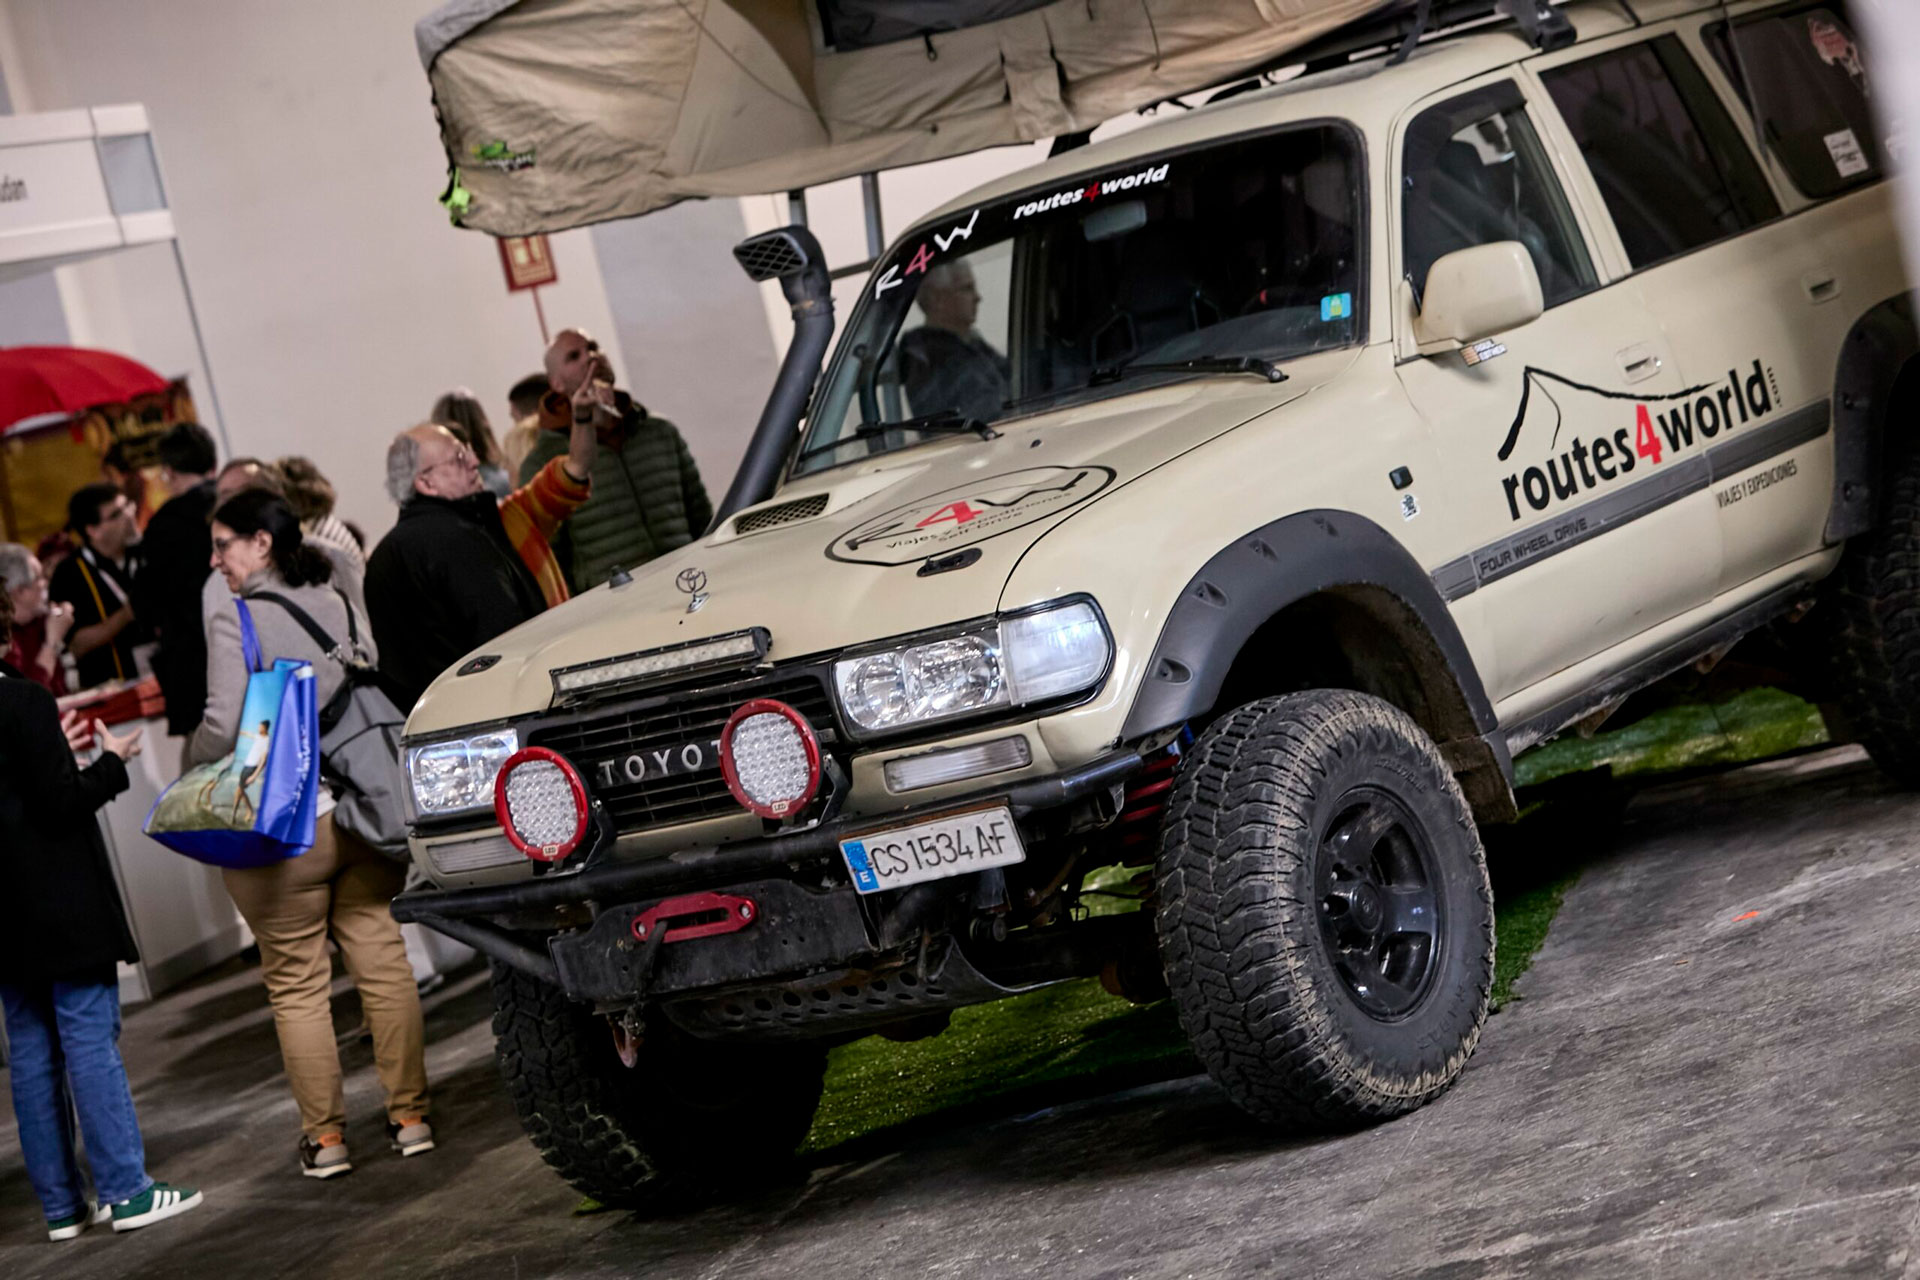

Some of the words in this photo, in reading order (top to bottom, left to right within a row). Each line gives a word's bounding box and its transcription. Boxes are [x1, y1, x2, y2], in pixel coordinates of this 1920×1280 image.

[1013, 164, 1170, 220] routes4world
[1501, 358, 1772, 522] routes4world
[1716, 484, 1742, 508] VIAJES
[1748, 459, 1797, 495] EXPEDICIONES
[1480, 553, 1512, 576] FOUR
[1513, 536, 1554, 559] WHEEL
[1555, 518, 1587, 541] DRIVE
[599, 739, 723, 786] TOYO
[774, 803, 787, 811] LED
[860, 871, 871, 883] E
